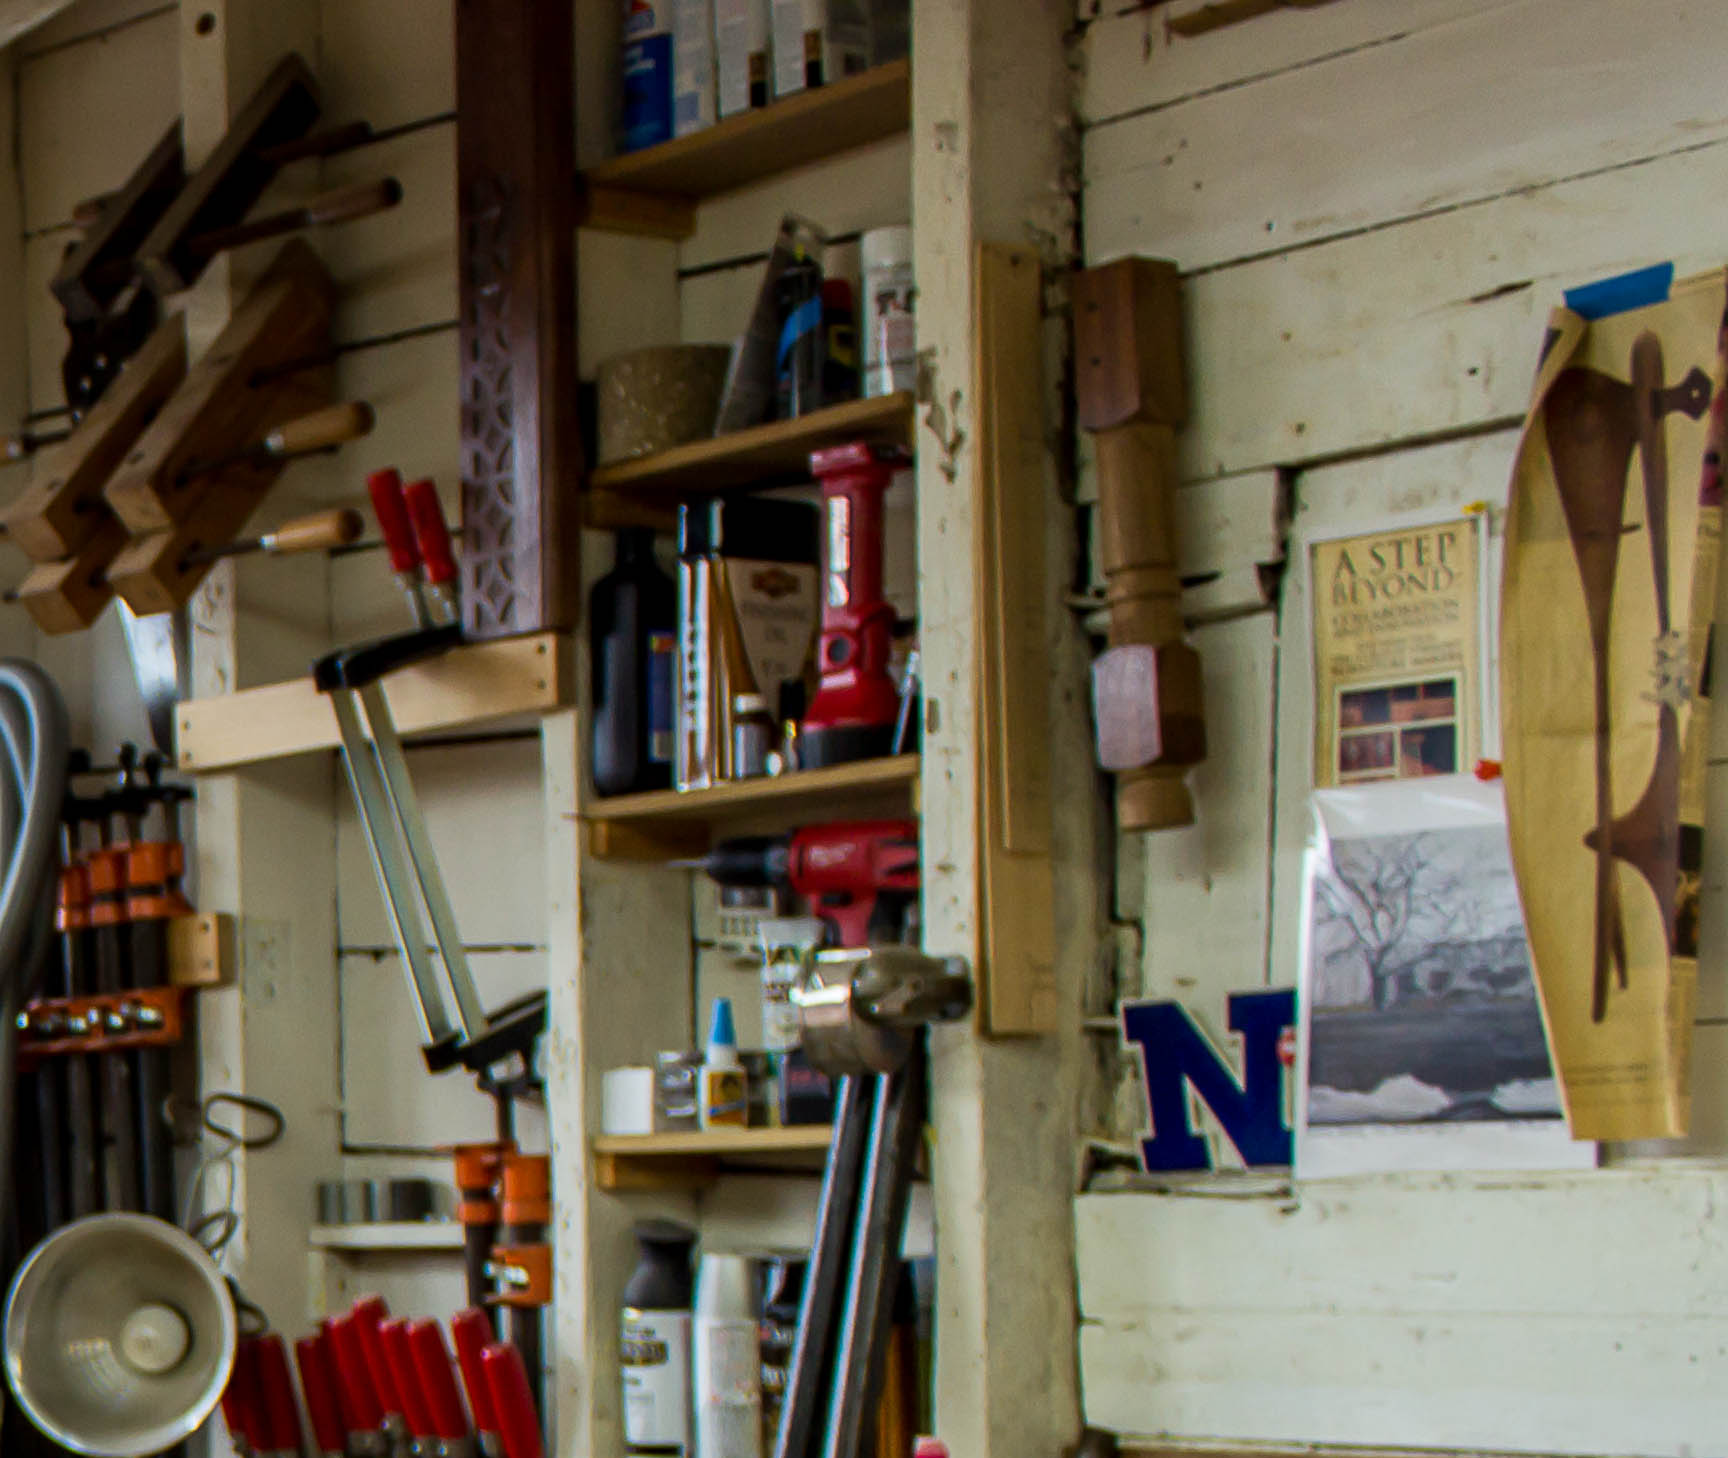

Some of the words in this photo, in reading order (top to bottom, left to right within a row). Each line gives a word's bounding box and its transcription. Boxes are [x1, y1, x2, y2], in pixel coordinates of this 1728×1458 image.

[1331, 548, 1357, 580] A
[1369, 532, 1455, 575] STEP
[1332, 564, 1456, 605] BEYOND
[1123, 987, 1297, 1172] N
